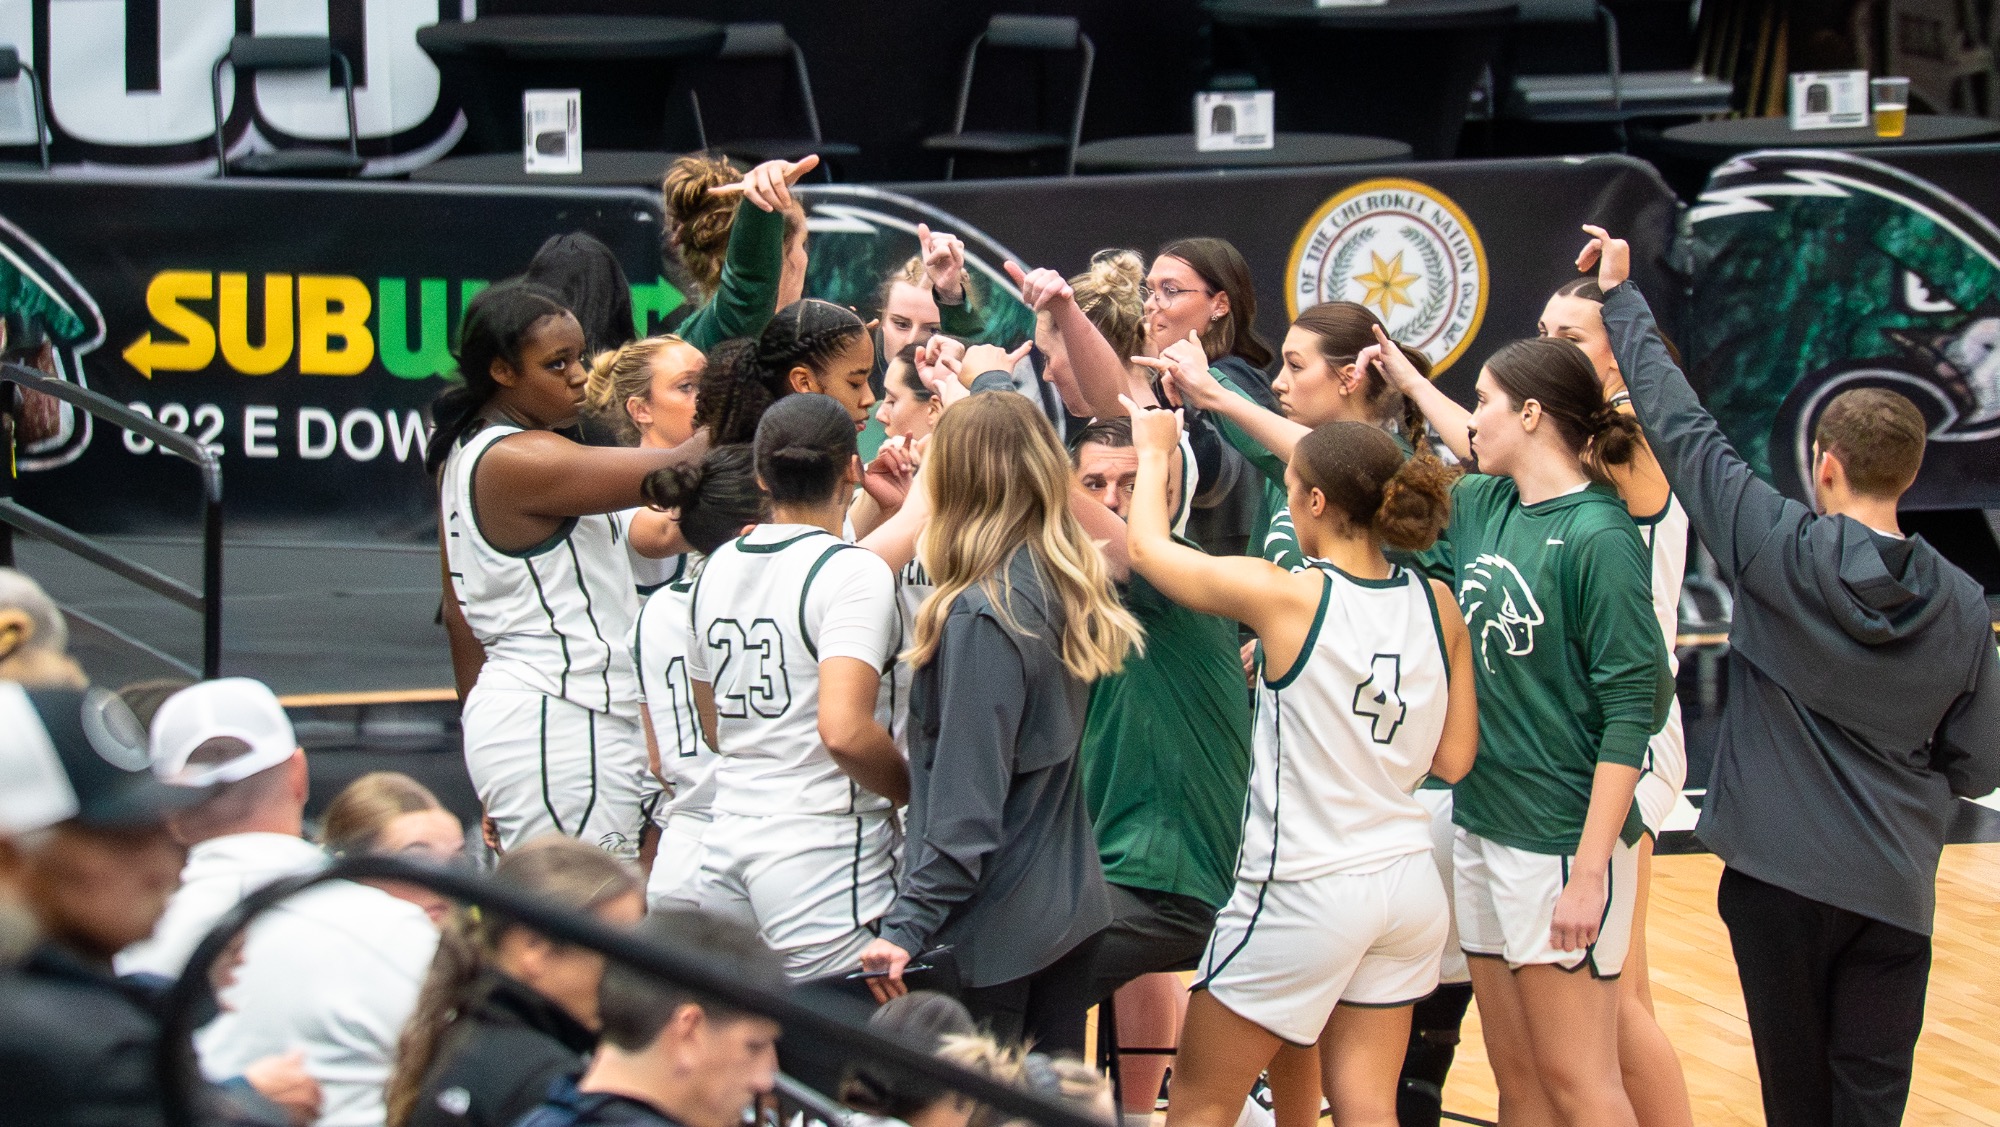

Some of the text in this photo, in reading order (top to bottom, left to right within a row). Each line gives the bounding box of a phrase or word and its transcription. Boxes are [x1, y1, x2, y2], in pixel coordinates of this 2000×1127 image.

[1301, 193, 1475, 295] OF THE CHEROKEE NATION
[122, 269, 687, 384] SUBW
[244, 405, 279, 458] E
[707, 617, 792, 719] 23
[1352, 653, 1407, 745] 4
